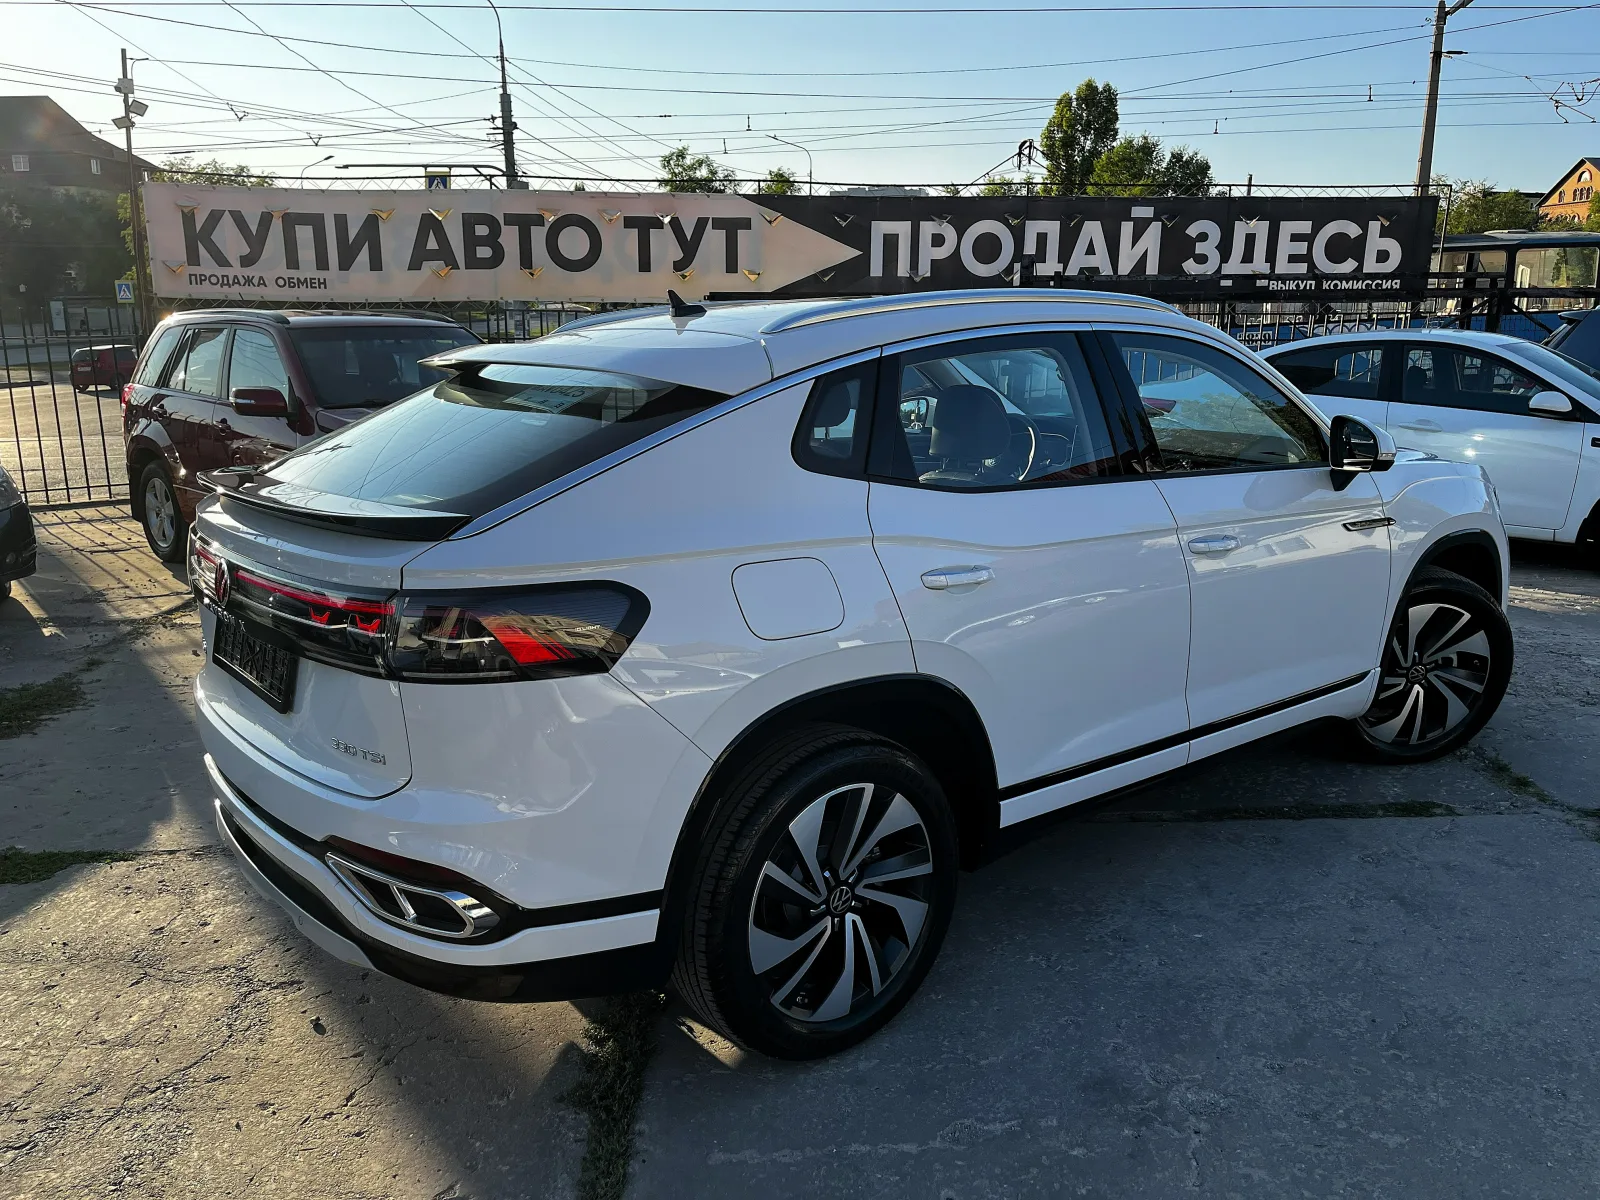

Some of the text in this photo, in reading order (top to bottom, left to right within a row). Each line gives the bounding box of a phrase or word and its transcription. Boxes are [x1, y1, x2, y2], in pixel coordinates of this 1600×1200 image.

[181, 209, 752, 273] КУПИ АВТО ТУТ
[870, 207, 1402, 286] ПРОДАЙ ЗДЕСЬ
[189, 273, 327, 290] ПРОДАЖА ОБМЕН
[1269, 280, 1400, 290] ВЫКУП КОМИССИЯ
[331, 737, 357, 756] 330
